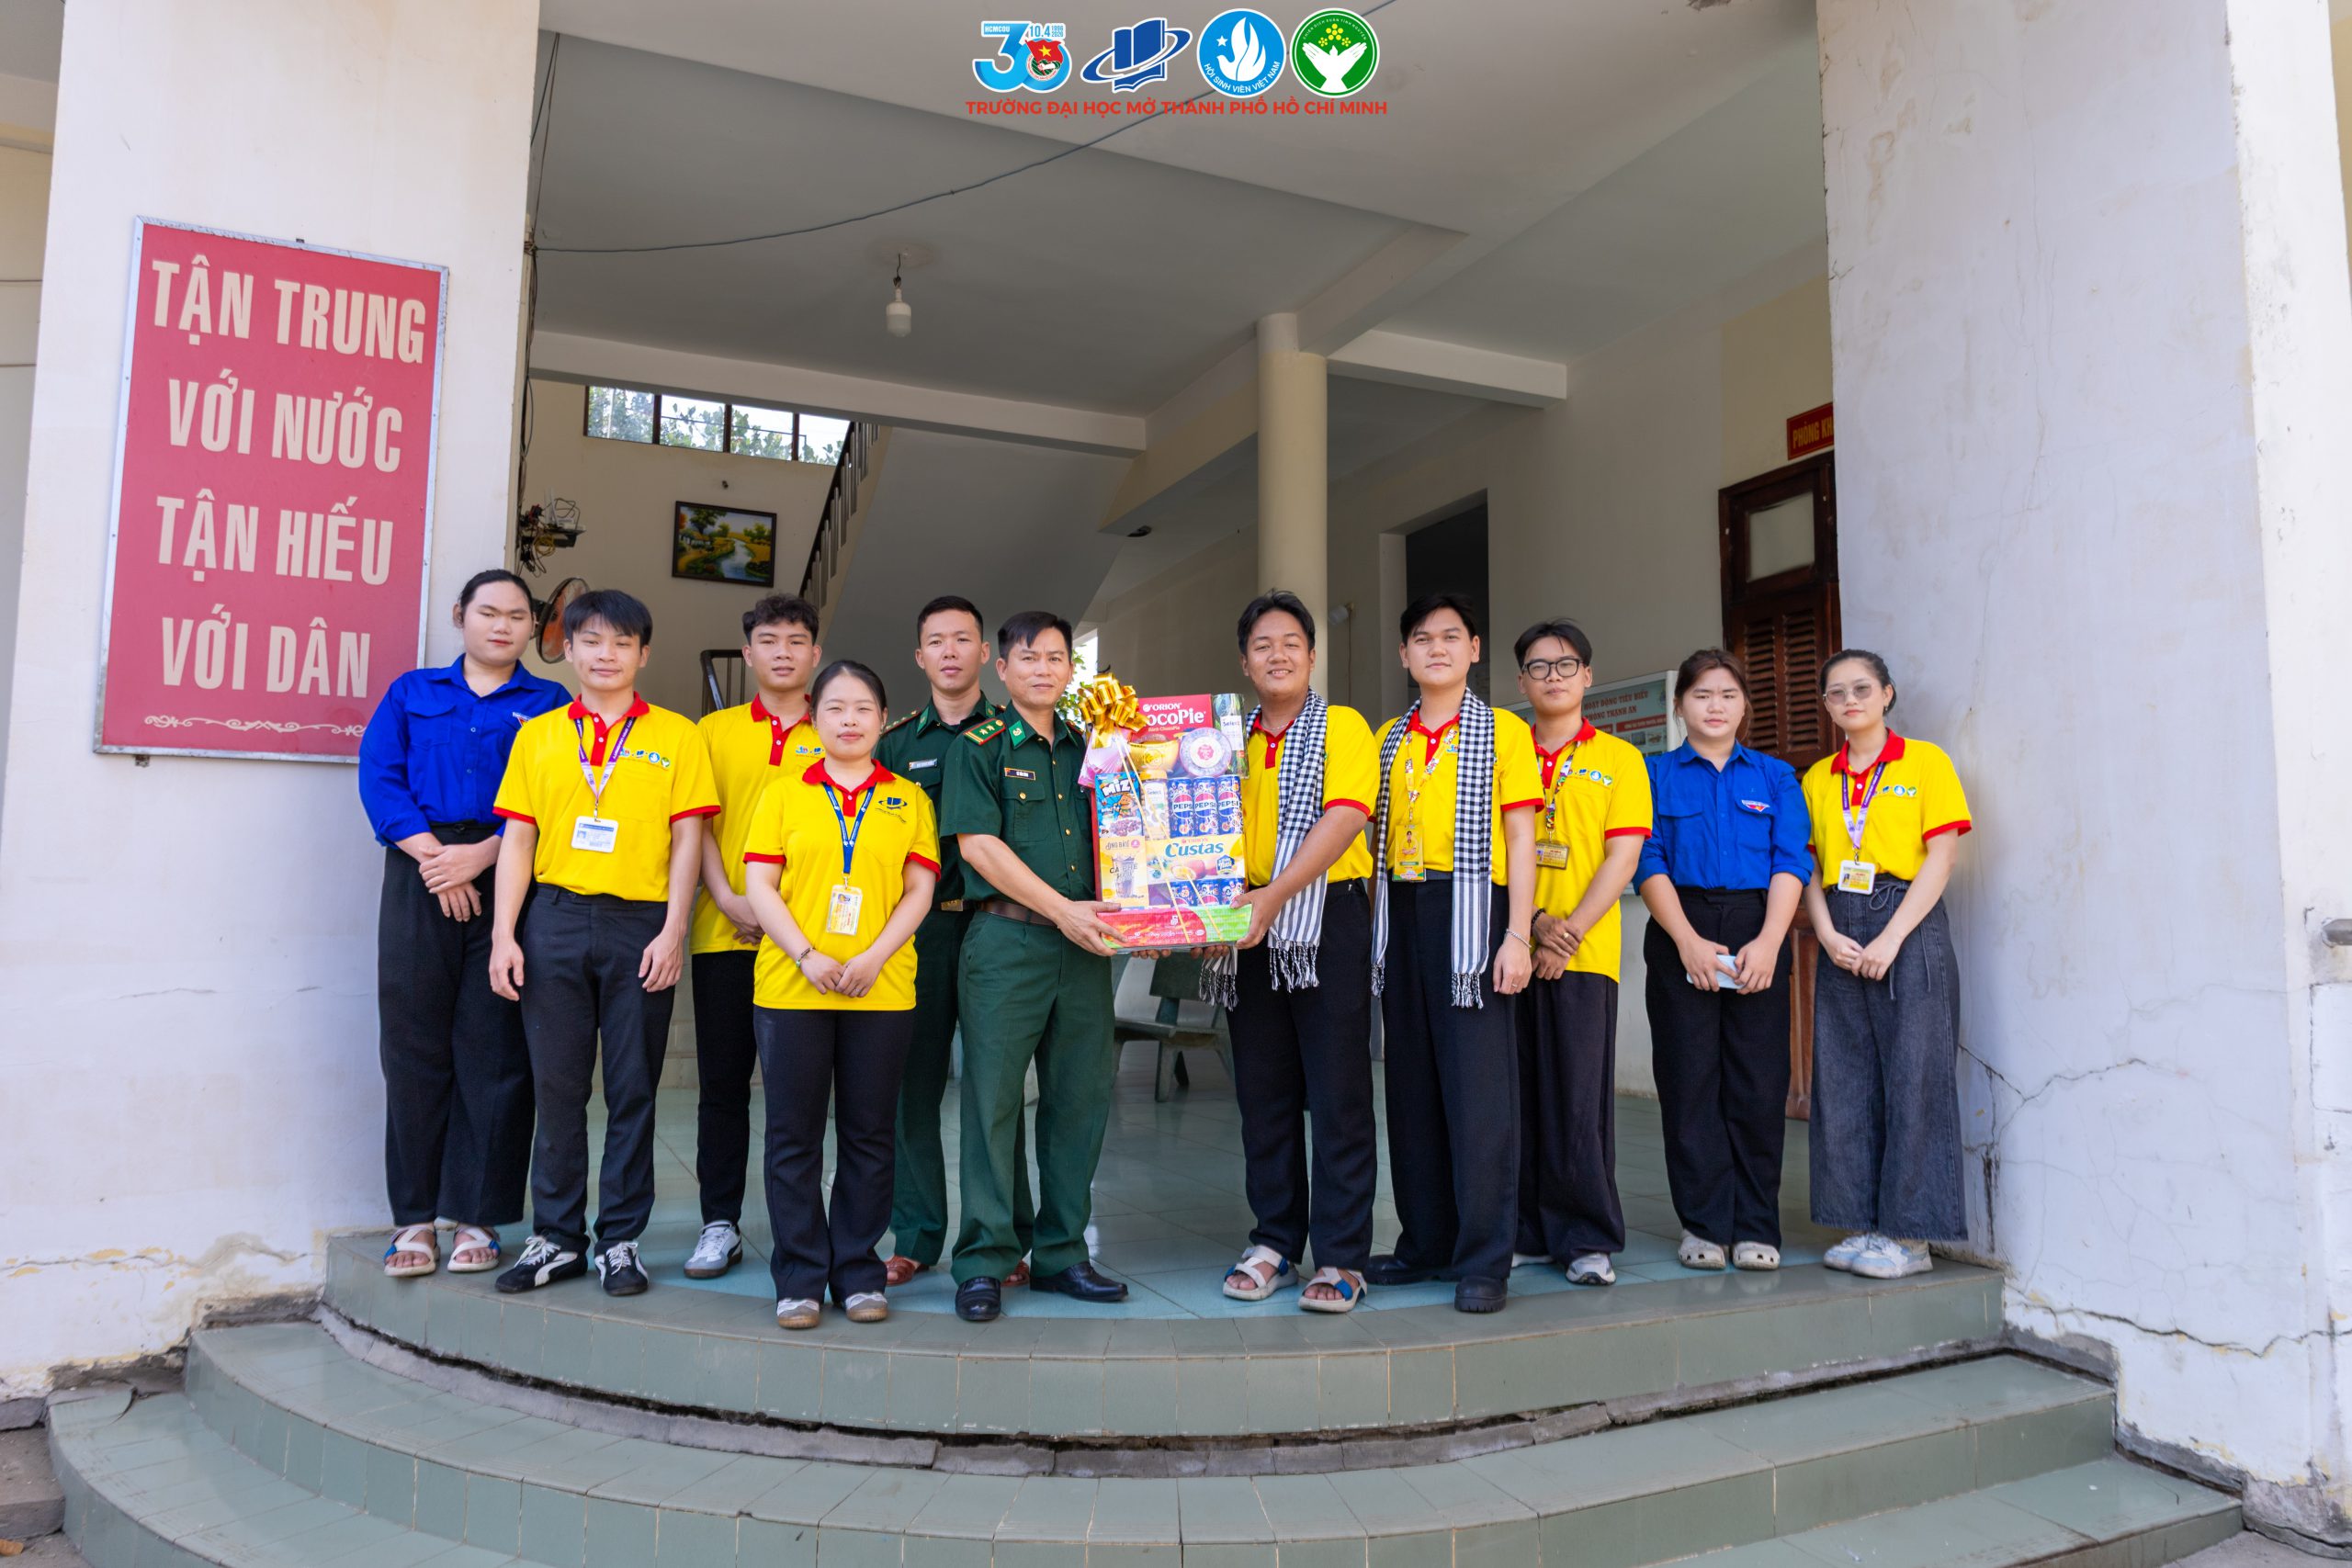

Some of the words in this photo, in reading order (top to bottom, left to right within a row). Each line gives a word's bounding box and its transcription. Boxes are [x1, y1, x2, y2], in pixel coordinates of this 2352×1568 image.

[152, 254, 254, 345] TẬN
[274, 278, 426, 364] TRUNG
[168, 368, 255, 455] VỚI
[271, 387, 402, 473] NƯỚC
[156, 488, 258, 582] TẬN
[276, 496, 393, 585] HIẾU
[162, 604, 248, 691] VỚI
[266, 617, 370, 698] DÂN
[1152, 703, 1181, 711] ORION
[1165, 842, 1224, 858] Custas
